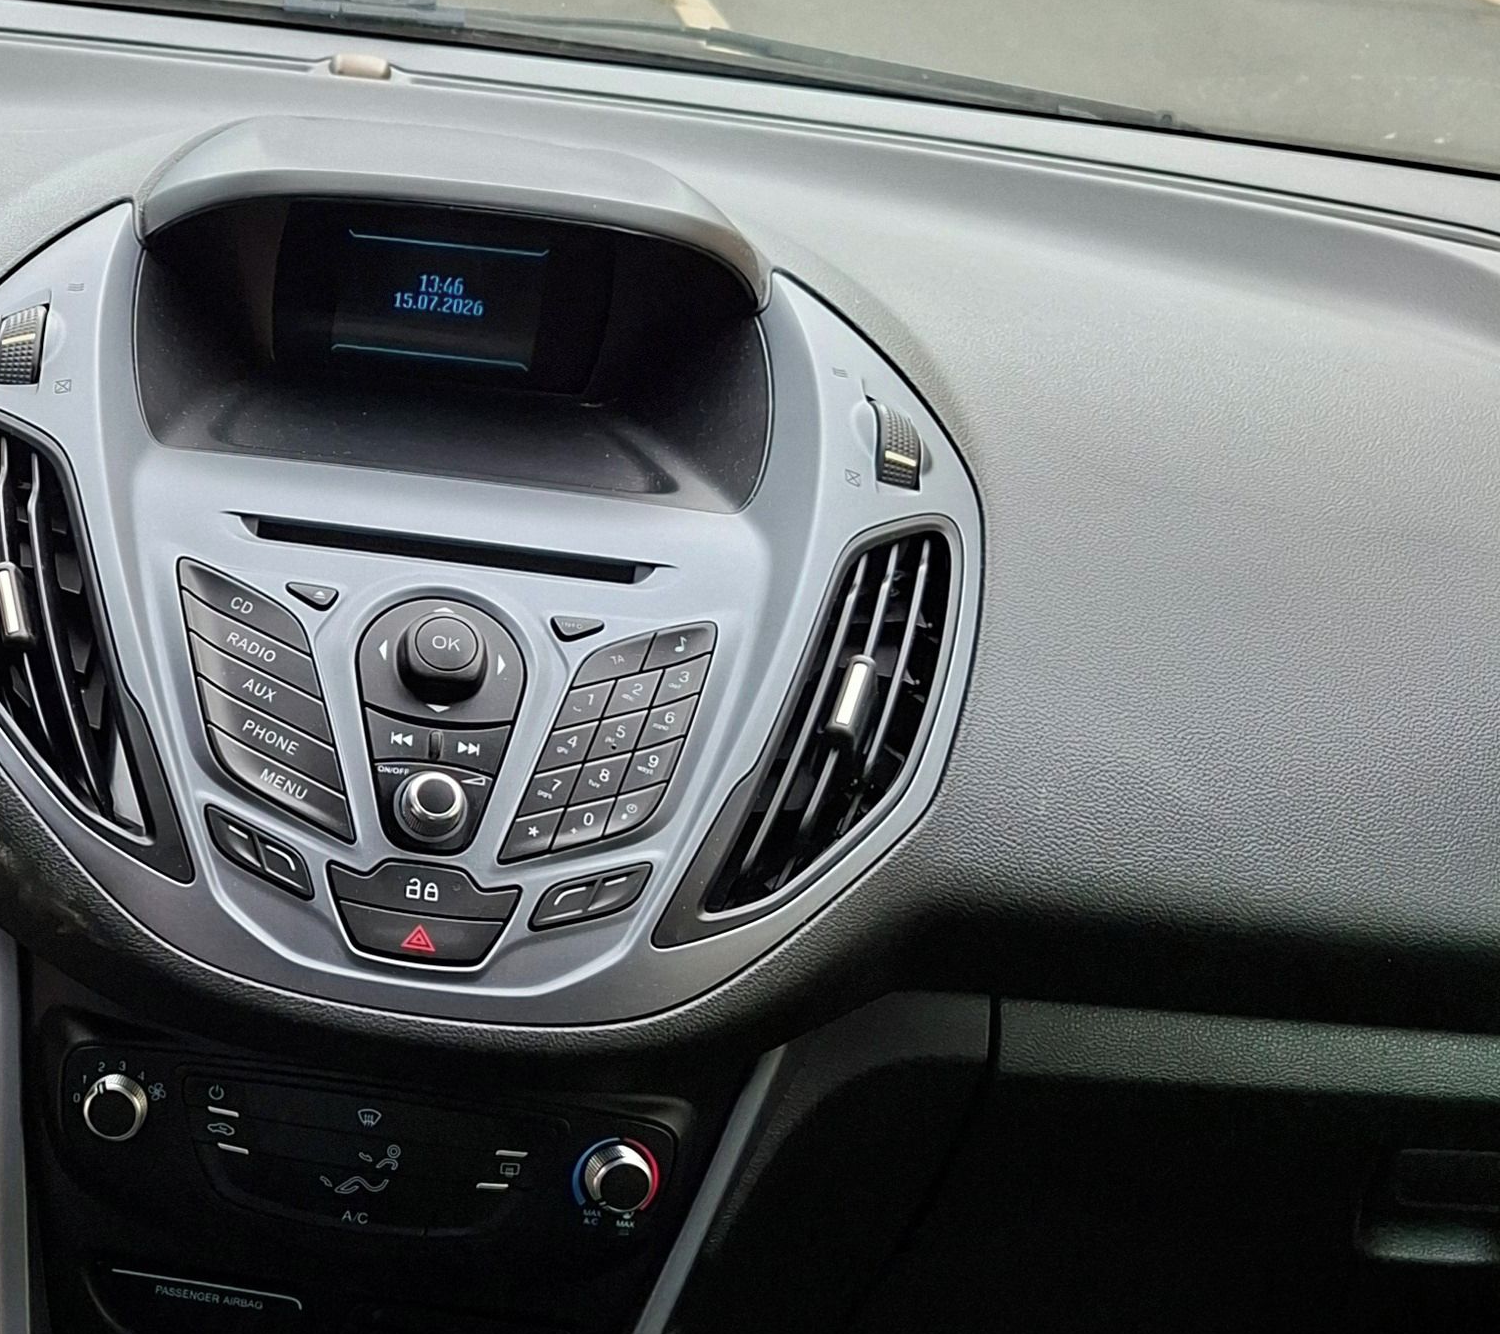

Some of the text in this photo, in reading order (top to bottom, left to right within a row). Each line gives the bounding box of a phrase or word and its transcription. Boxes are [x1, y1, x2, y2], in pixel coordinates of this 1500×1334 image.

[418, 274, 465, 297] 13:46
[393, 292, 485, 317] 15.07.2026
[230, 595, 255, 616] CD
[226, 630, 277, 663] RADIO
[431, 634, 461, 652] OK
[678, 671, 691, 683] 3
[241, 676, 278, 705] AUX
[632, 683, 644, 696] 2
[587, 694, 595, 706] 1
[664, 711, 676, 724] 6
[241, 719, 300, 757] PHONE
[615, 725, 626, 739] 5
[567, 735, 578, 748] 4
[647, 755, 660, 768] 9
[377, 764, 410, 776] ON/OFF
[599, 768, 610, 782] 8
[259, 767, 308, 802] MENU
[551, 779, 562, 792] 7
[583, 812, 594, 826] 0
[97, 1061, 106, 1073] 2
[118, 1060, 127, 1071] 3
[137, 1071, 146, 1081] 4
[72, 1092, 81, 1103] 0
[341, 1210, 369, 1226] A/C
[616, 1219, 636, 1229] MAX
[154, 1284, 264, 1311] PASSENGER AIRBAG
